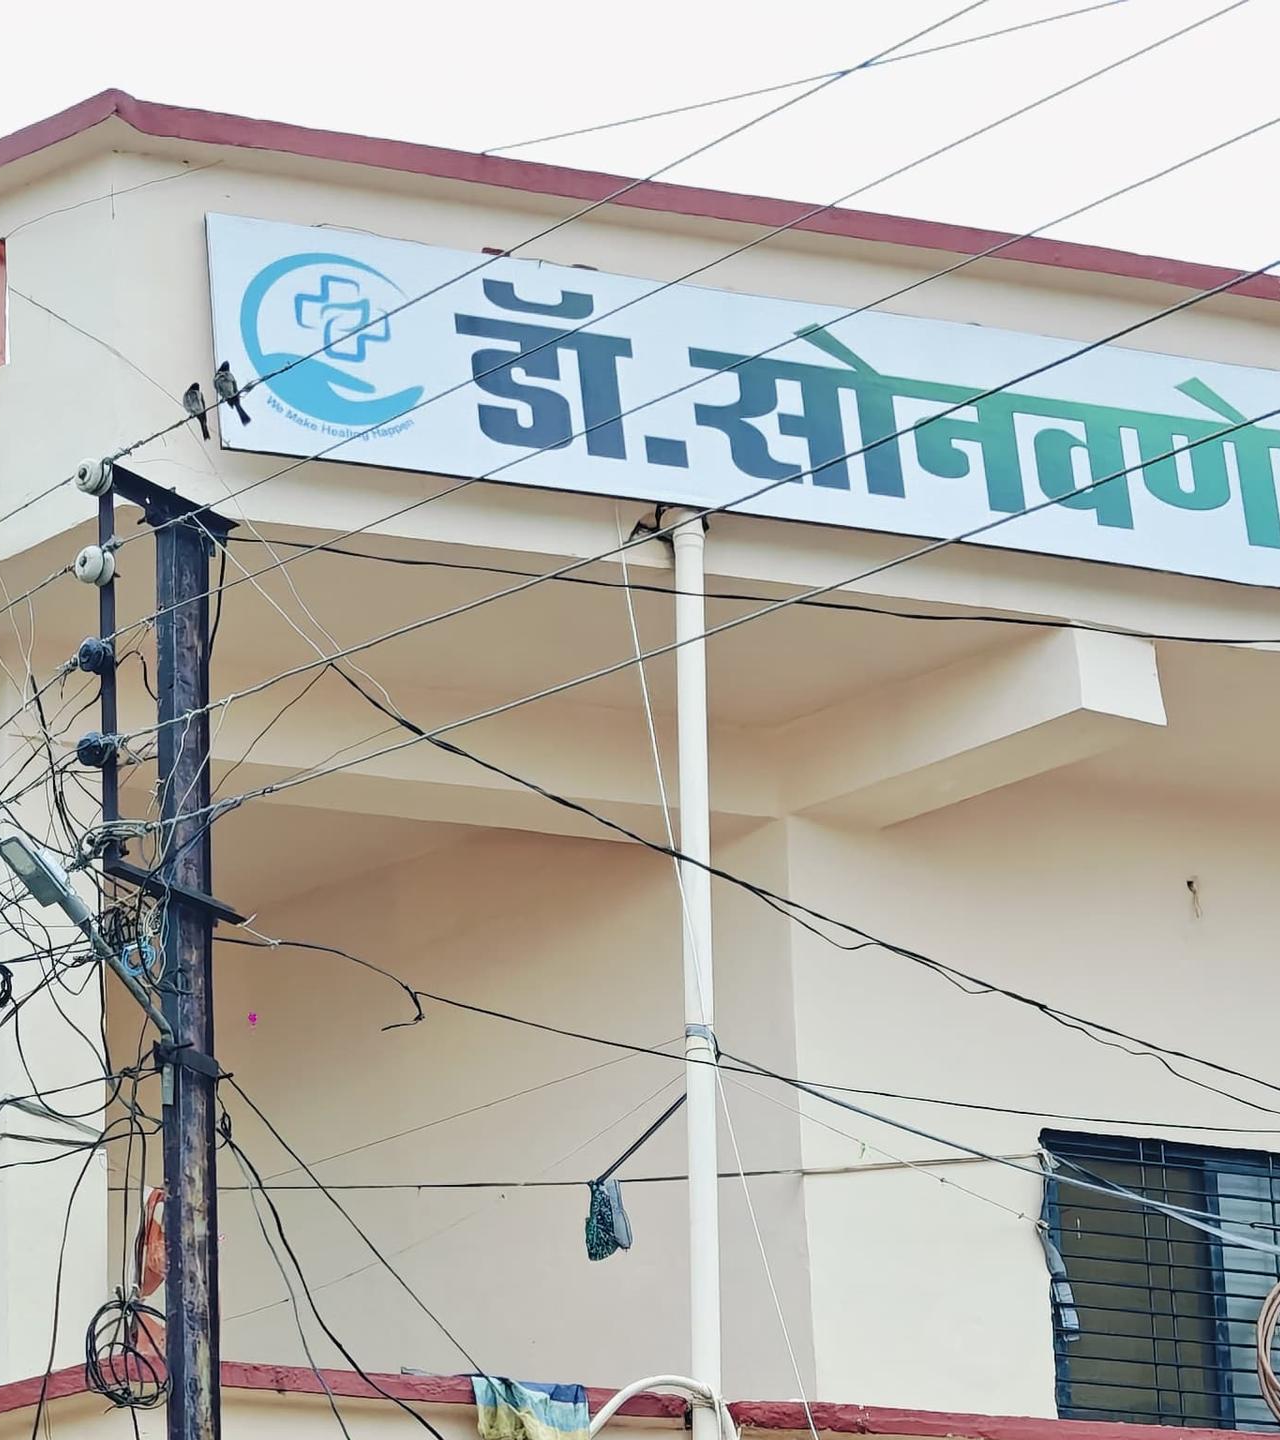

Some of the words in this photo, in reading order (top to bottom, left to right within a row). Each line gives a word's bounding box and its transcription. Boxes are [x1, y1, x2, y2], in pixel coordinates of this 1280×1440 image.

[286, 408, 318, 431] Make
[321, 423, 371, 442] Healing
[371, 418, 415, 439] Happen
